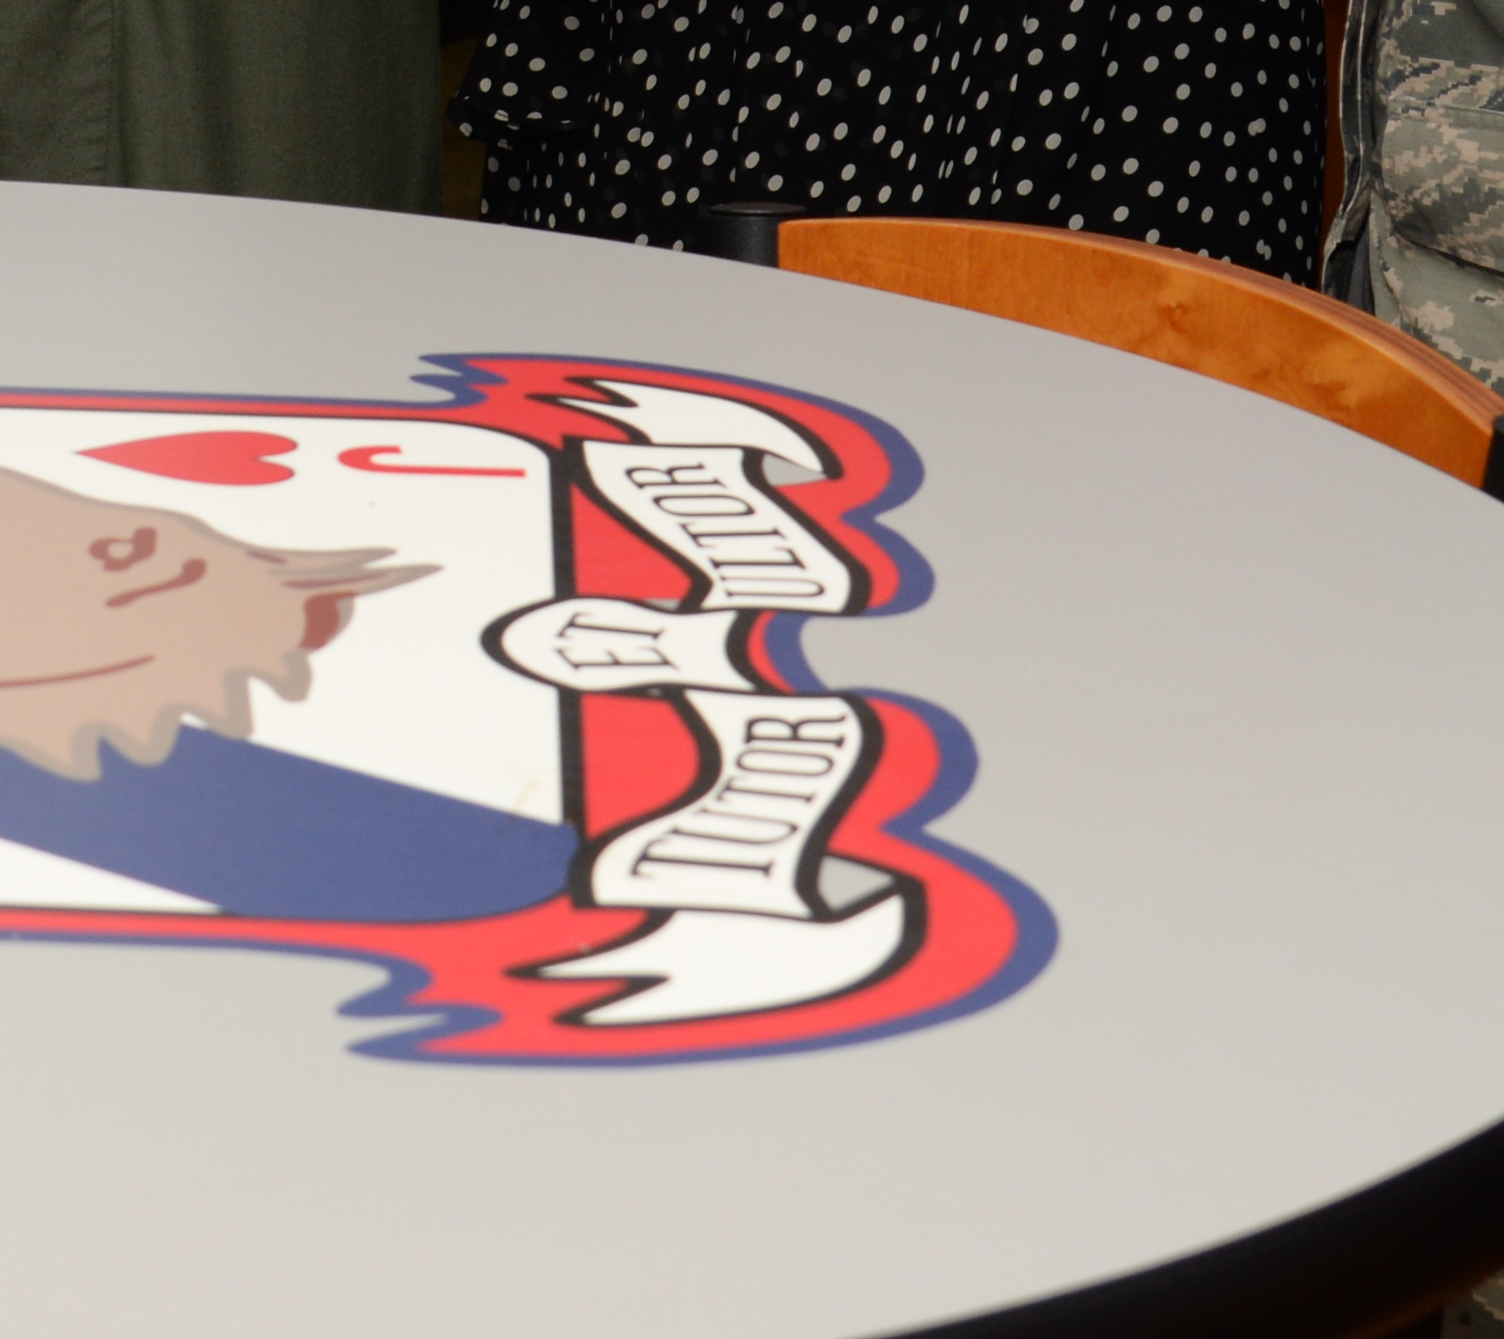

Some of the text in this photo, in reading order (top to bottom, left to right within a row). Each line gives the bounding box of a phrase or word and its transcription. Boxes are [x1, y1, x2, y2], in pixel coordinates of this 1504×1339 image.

[624, 461, 826, 599] ULTOR
[554, 612, 682, 671] ET
[629, 714, 848, 880] TUTOR
